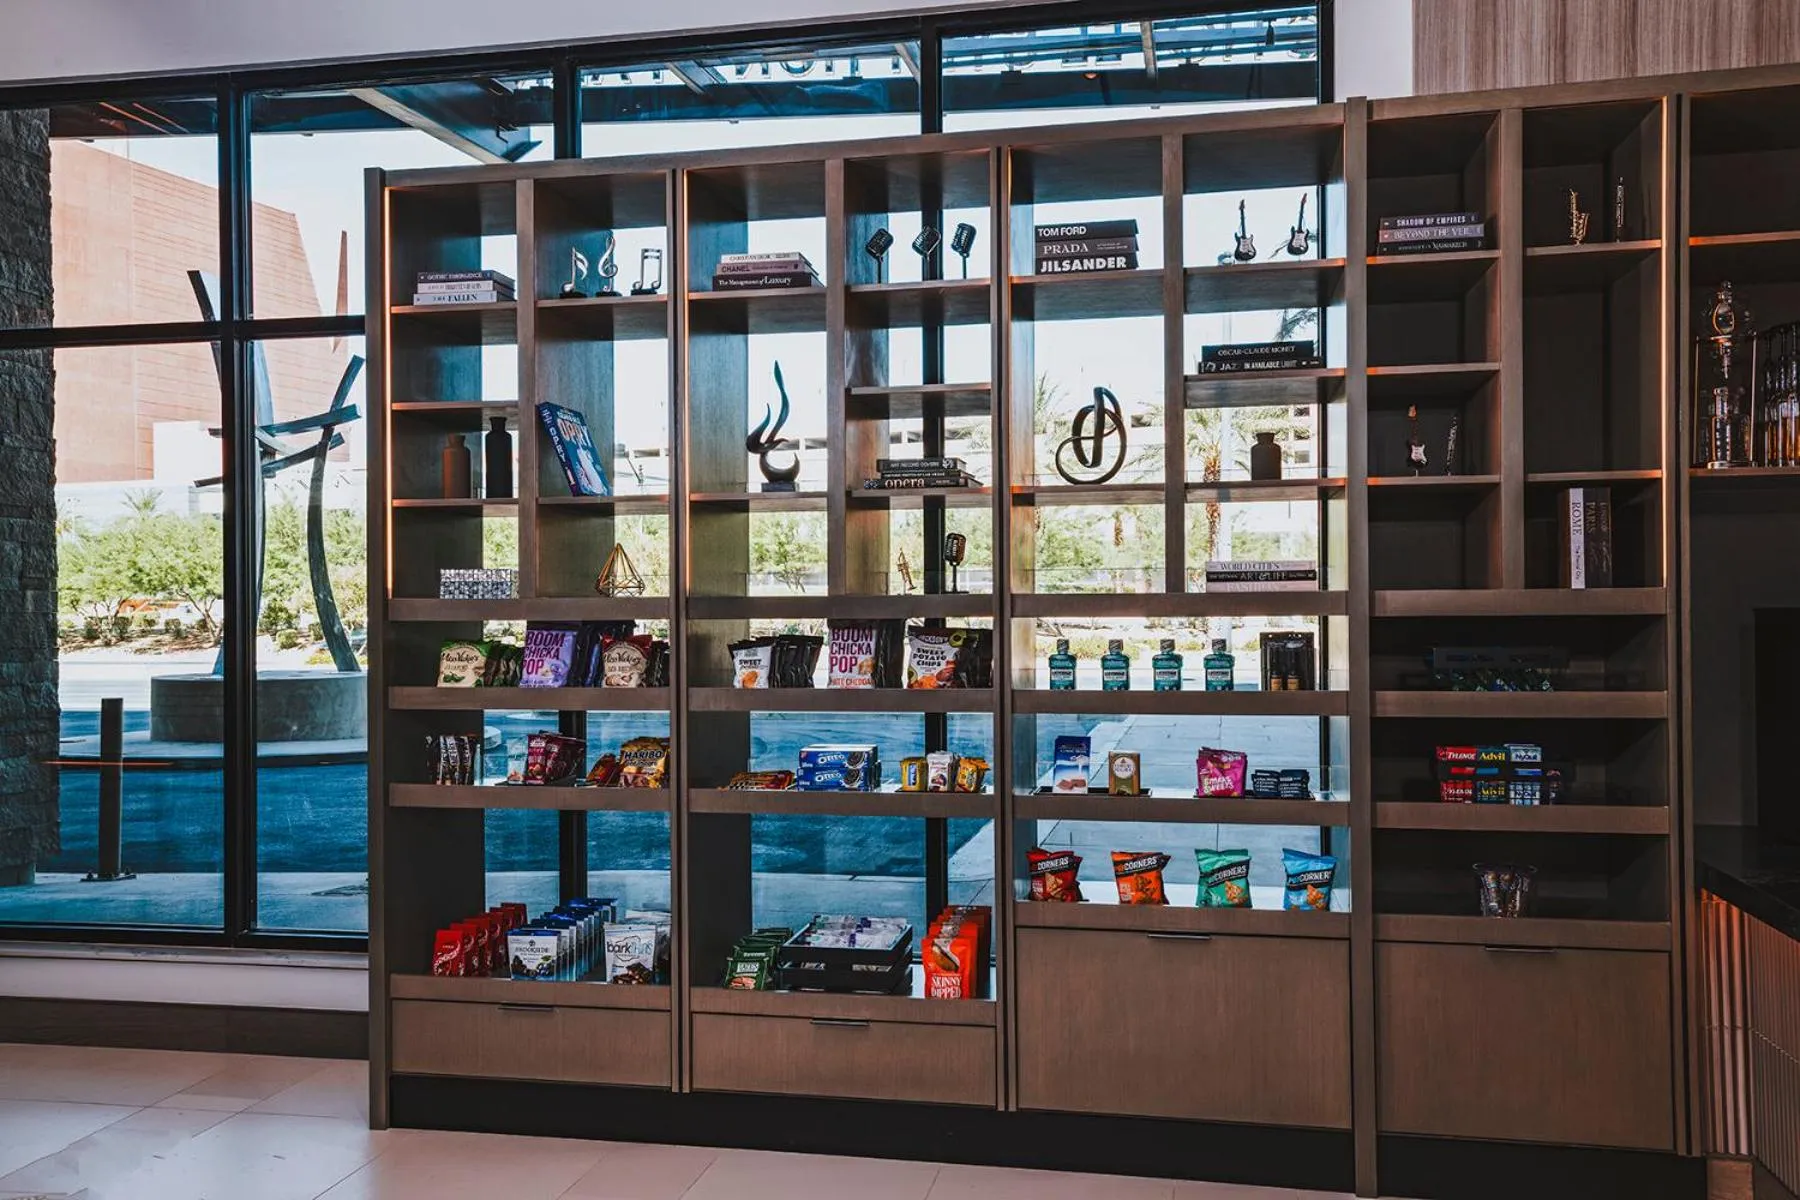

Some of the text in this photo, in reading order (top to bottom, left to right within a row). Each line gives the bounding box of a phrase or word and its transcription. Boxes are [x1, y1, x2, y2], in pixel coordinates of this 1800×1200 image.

[1038, 226, 1087, 237] TOM FORD
[1043, 243, 1089, 254] PRADA
[721, 264, 751, 273] CHANEL
[764, 275, 792, 286] Luxury
[1571, 502, 1582, 536] ROME
[526, 631, 566, 647] BOOM
[830, 626, 873, 642] BOOM
[830, 642, 872, 655] CHICKA
[829, 656, 858, 673] POP
[624, 750, 663, 760] HARIBO
[818, 754, 845, 764] OREO
[1480, 751, 1506, 761] Advil
[814, 772, 842, 782] OREO
